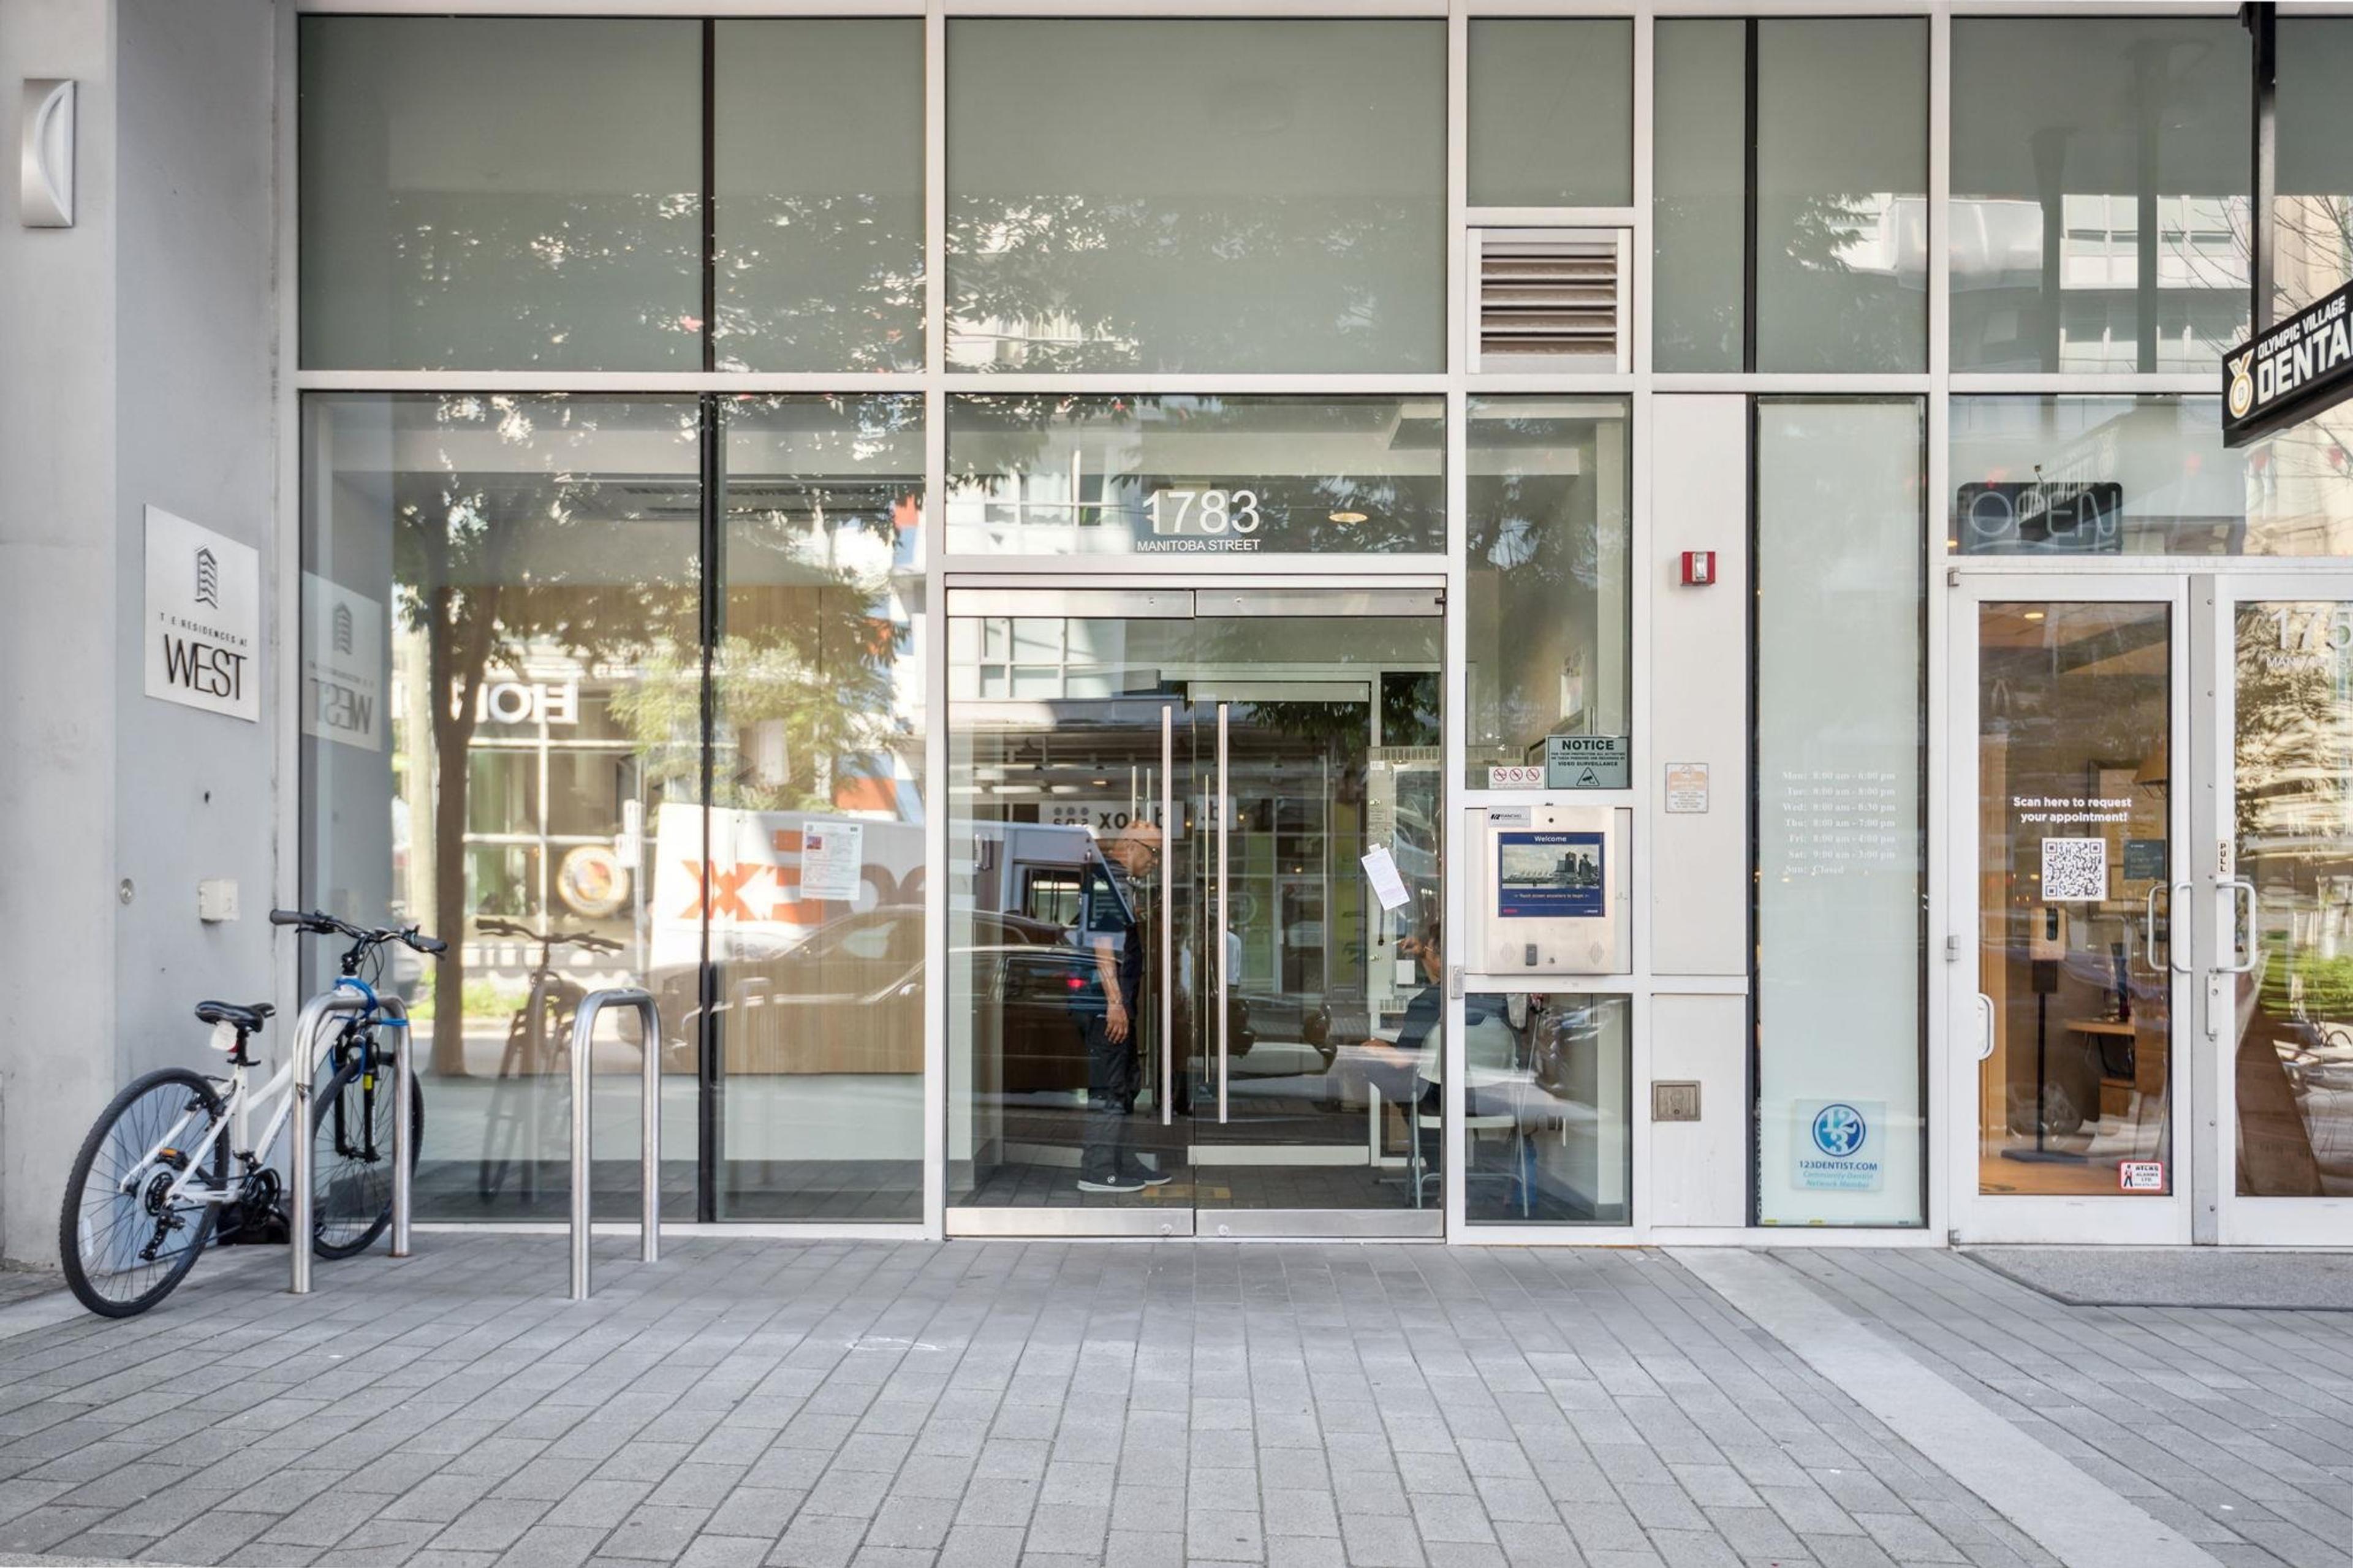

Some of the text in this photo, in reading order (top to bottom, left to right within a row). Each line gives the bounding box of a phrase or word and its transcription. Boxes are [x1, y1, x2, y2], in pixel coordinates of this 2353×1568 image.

[2257, 295, 2346, 360] OLYMPIC VILLAGE
[1142, 490, 1260, 534] 1783
[1968, 491, 2116, 538] OPEN
[1137, 539, 1261, 551] MANITOBA STREET
[164, 633, 248, 700] WEST
[1562, 740, 1615, 751] NOTICE
[2014, 797, 2132, 809] Scan here to request
[2021, 812, 2128, 823] your appointment!
[1800, 1161, 1877, 1171] 123DENTIST.COM
